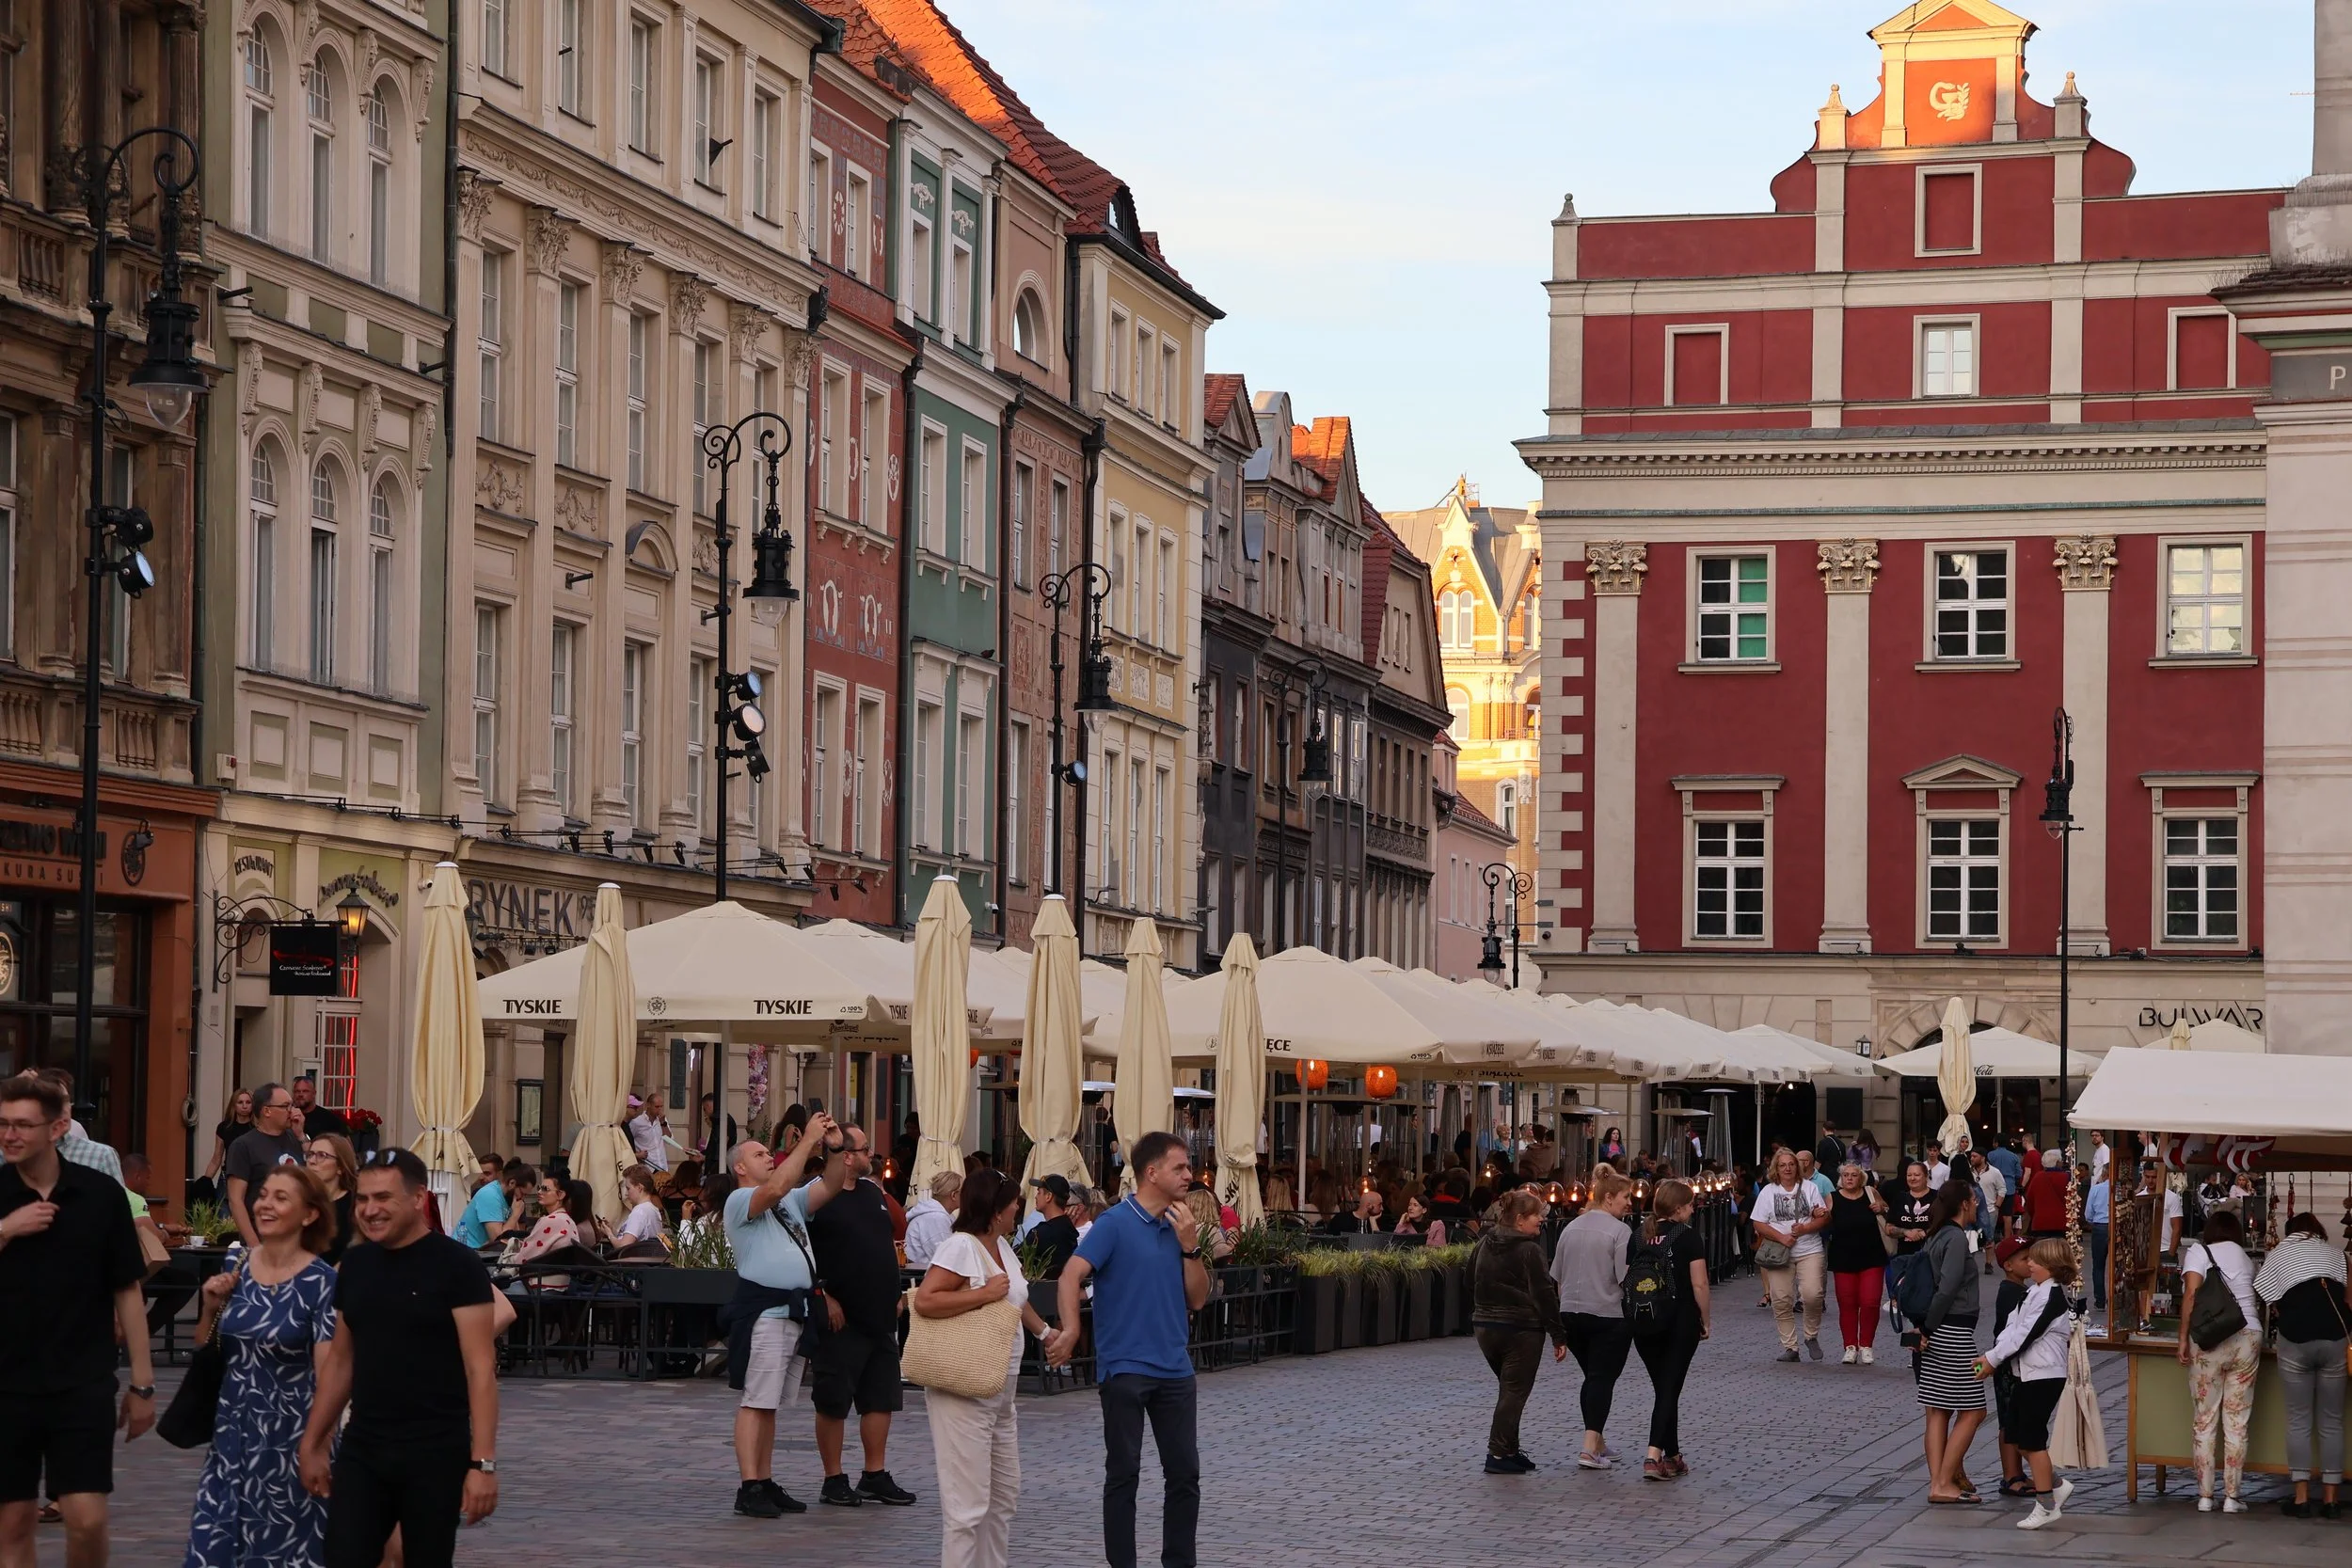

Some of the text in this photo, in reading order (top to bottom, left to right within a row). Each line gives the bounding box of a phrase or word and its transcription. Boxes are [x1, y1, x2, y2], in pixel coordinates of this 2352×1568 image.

[469, 879, 575, 937] RYNEK
[502, 999, 562, 1014] TYSKIE
[754, 1000, 813, 1015] TYSKIE
[889, 1005, 908, 1020] TYSKIE
[967, 1009, 978, 1023] SKIE
[1900, 1214, 1929, 1223] addas
